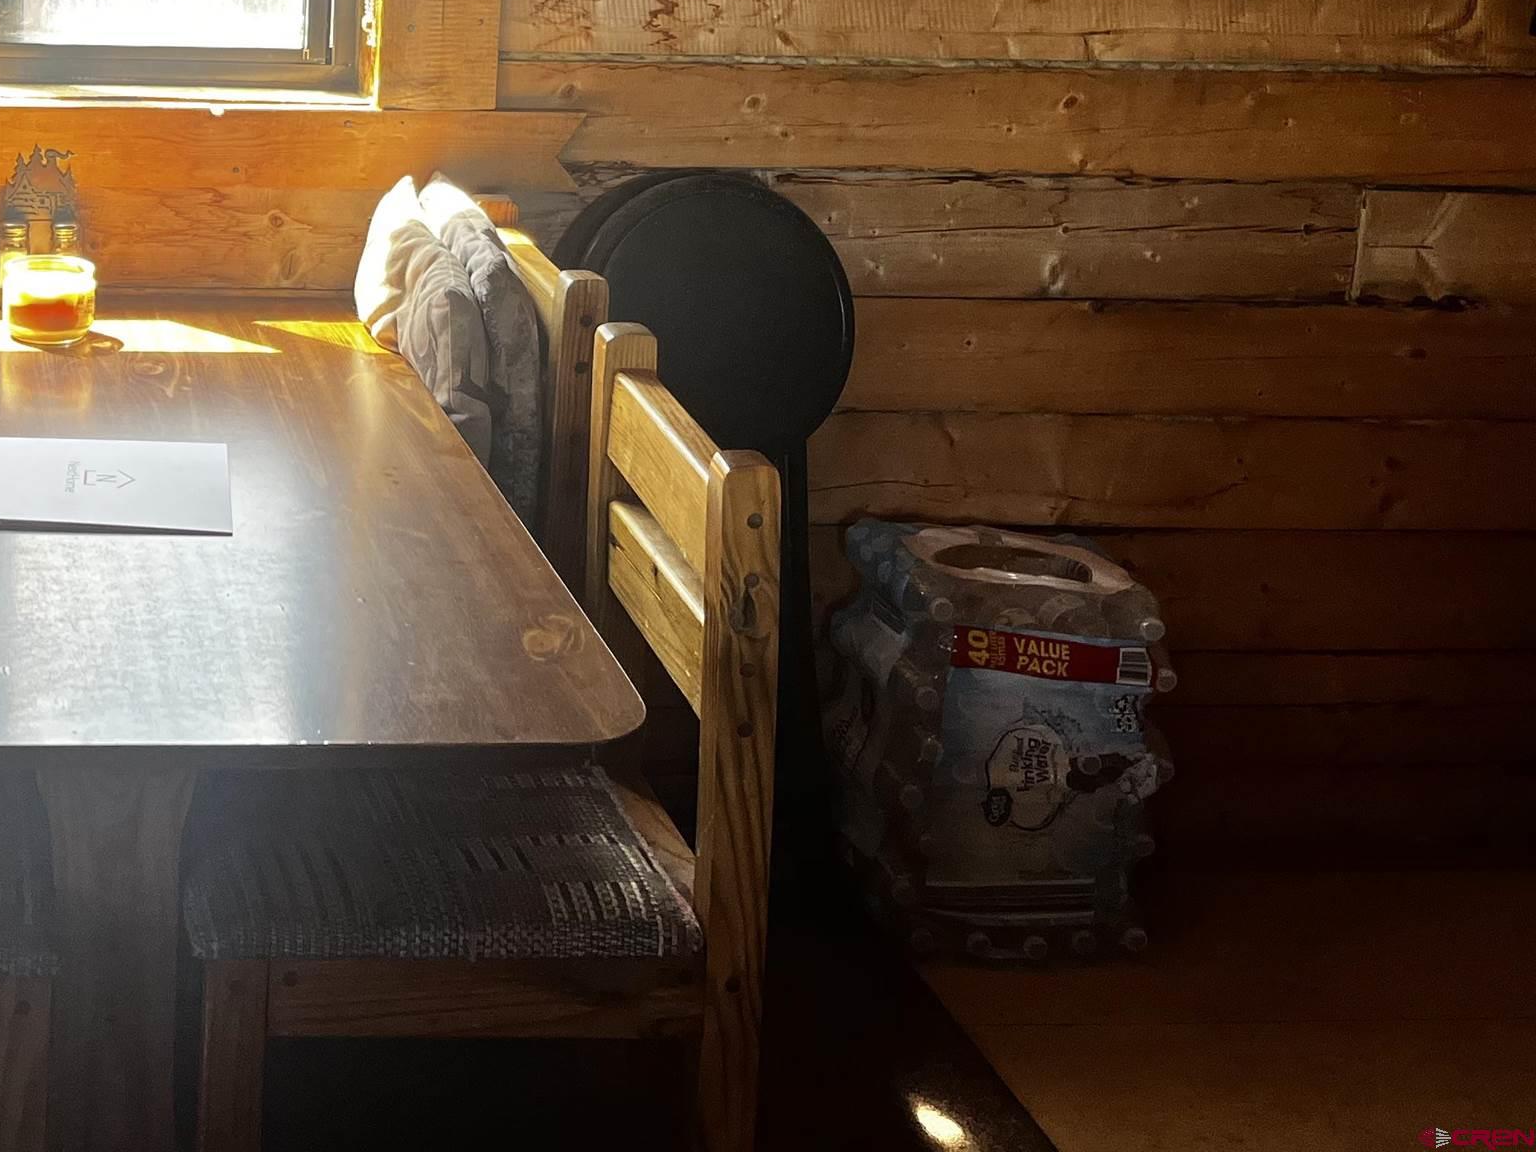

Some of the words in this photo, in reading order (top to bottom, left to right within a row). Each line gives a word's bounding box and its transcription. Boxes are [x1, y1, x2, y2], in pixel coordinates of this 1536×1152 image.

[967, 629, 990, 667] 40
[1013, 638, 1071, 660] VALUE
[1016, 655, 1069, 678] PACK
